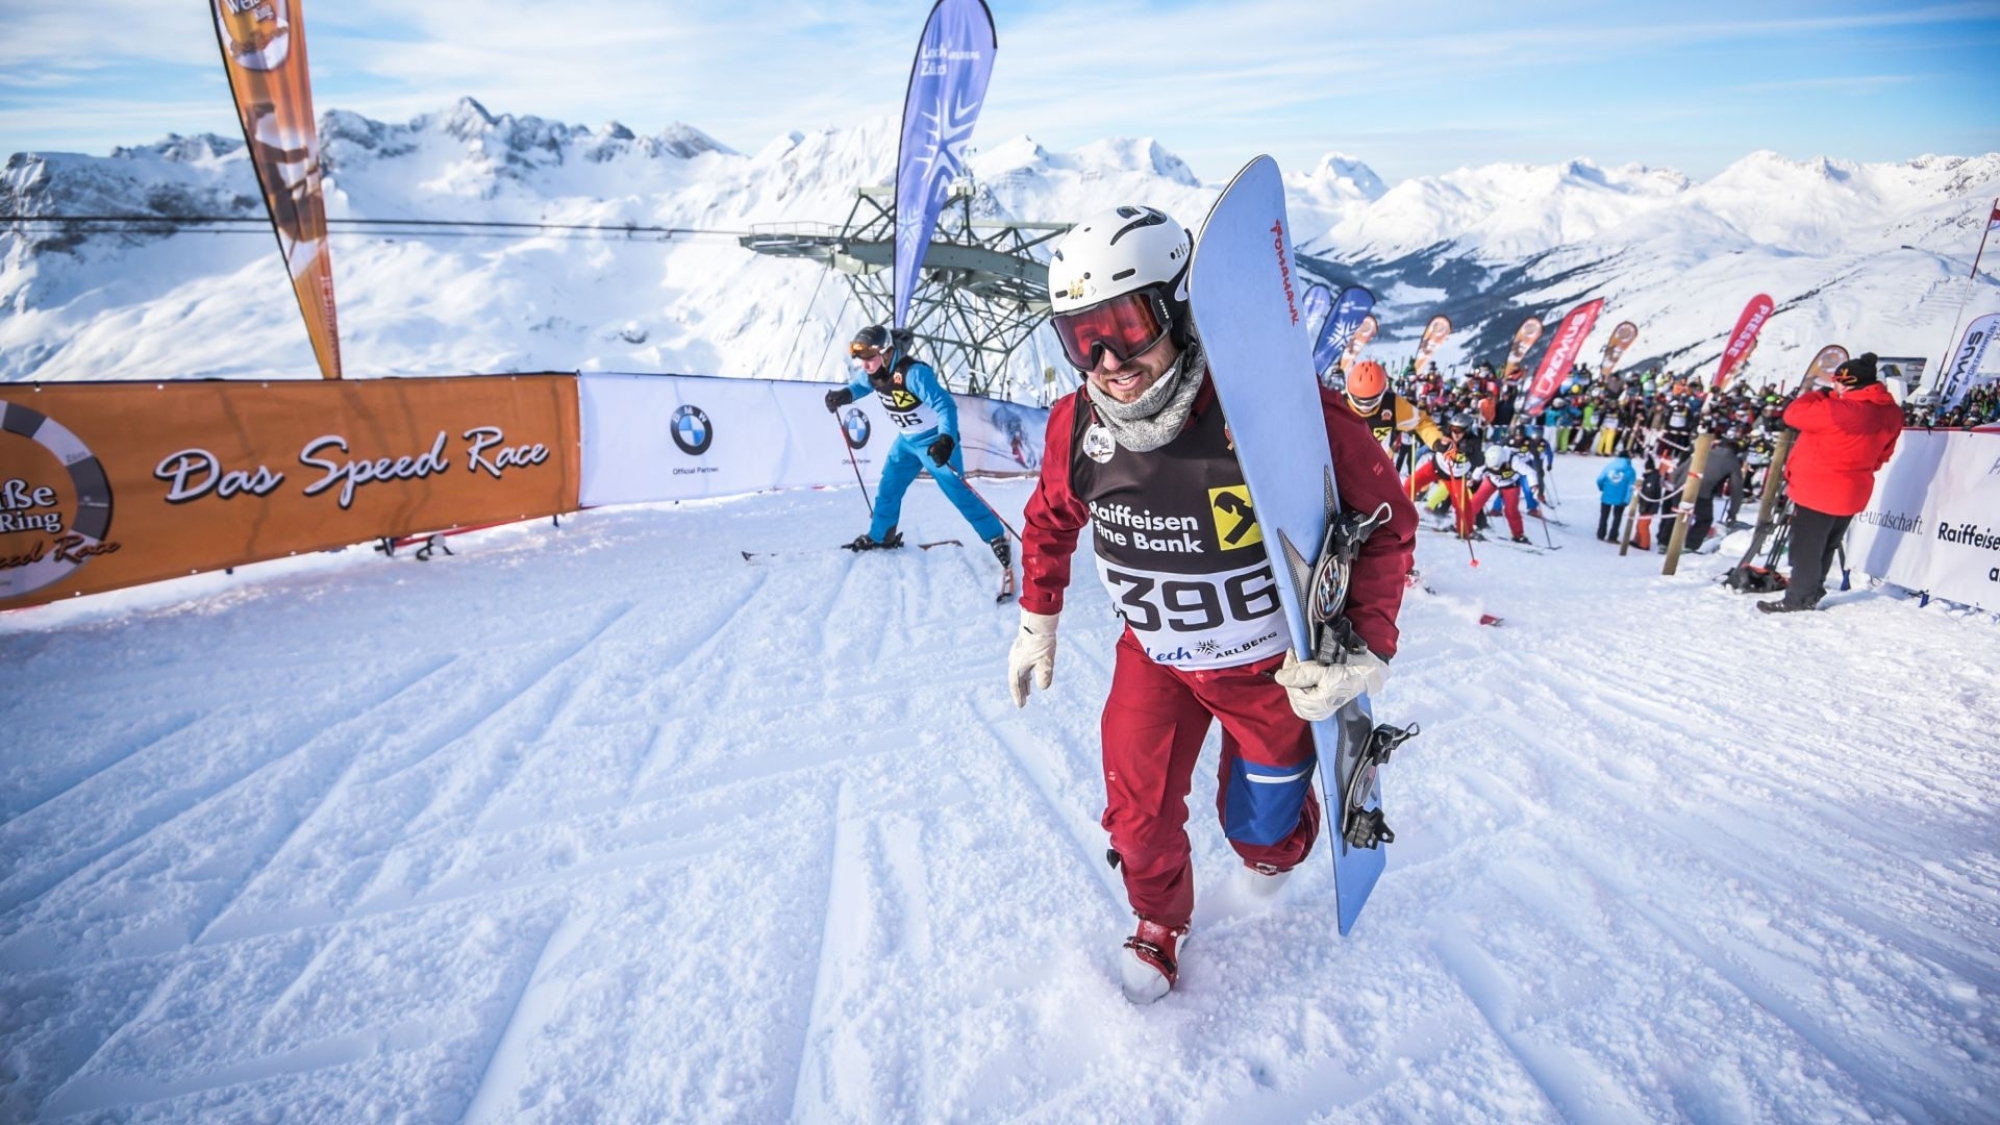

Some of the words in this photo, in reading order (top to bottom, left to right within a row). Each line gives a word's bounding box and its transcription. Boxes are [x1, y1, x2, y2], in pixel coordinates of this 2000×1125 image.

[1270, 218, 1299, 327] TOMAHAWK
[1544, 312, 1587, 380] REMUS
[1726, 304, 1770, 357] PRESSE
[672, 406, 707, 423] BMW
[153, 448, 284, 501] Das
[299, 430, 449, 508] Speed
[462, 425, 550, 478] Race
[672, 467, 696, 476] Official
[696, 466, 720, 474] Partner
[1088, 500, 1199, 531] Raiffeisen
[1853, 510, 1924, 536] eundschaft.
[53, 534, 122, 564] Race
[1132, 531, 1205, 554] Bank
[1937, 521, 2000, 552] Raiffeise
[1106, 564, 1281, 633] 396
[1214, 631, 1278, 659] ARLBERG
